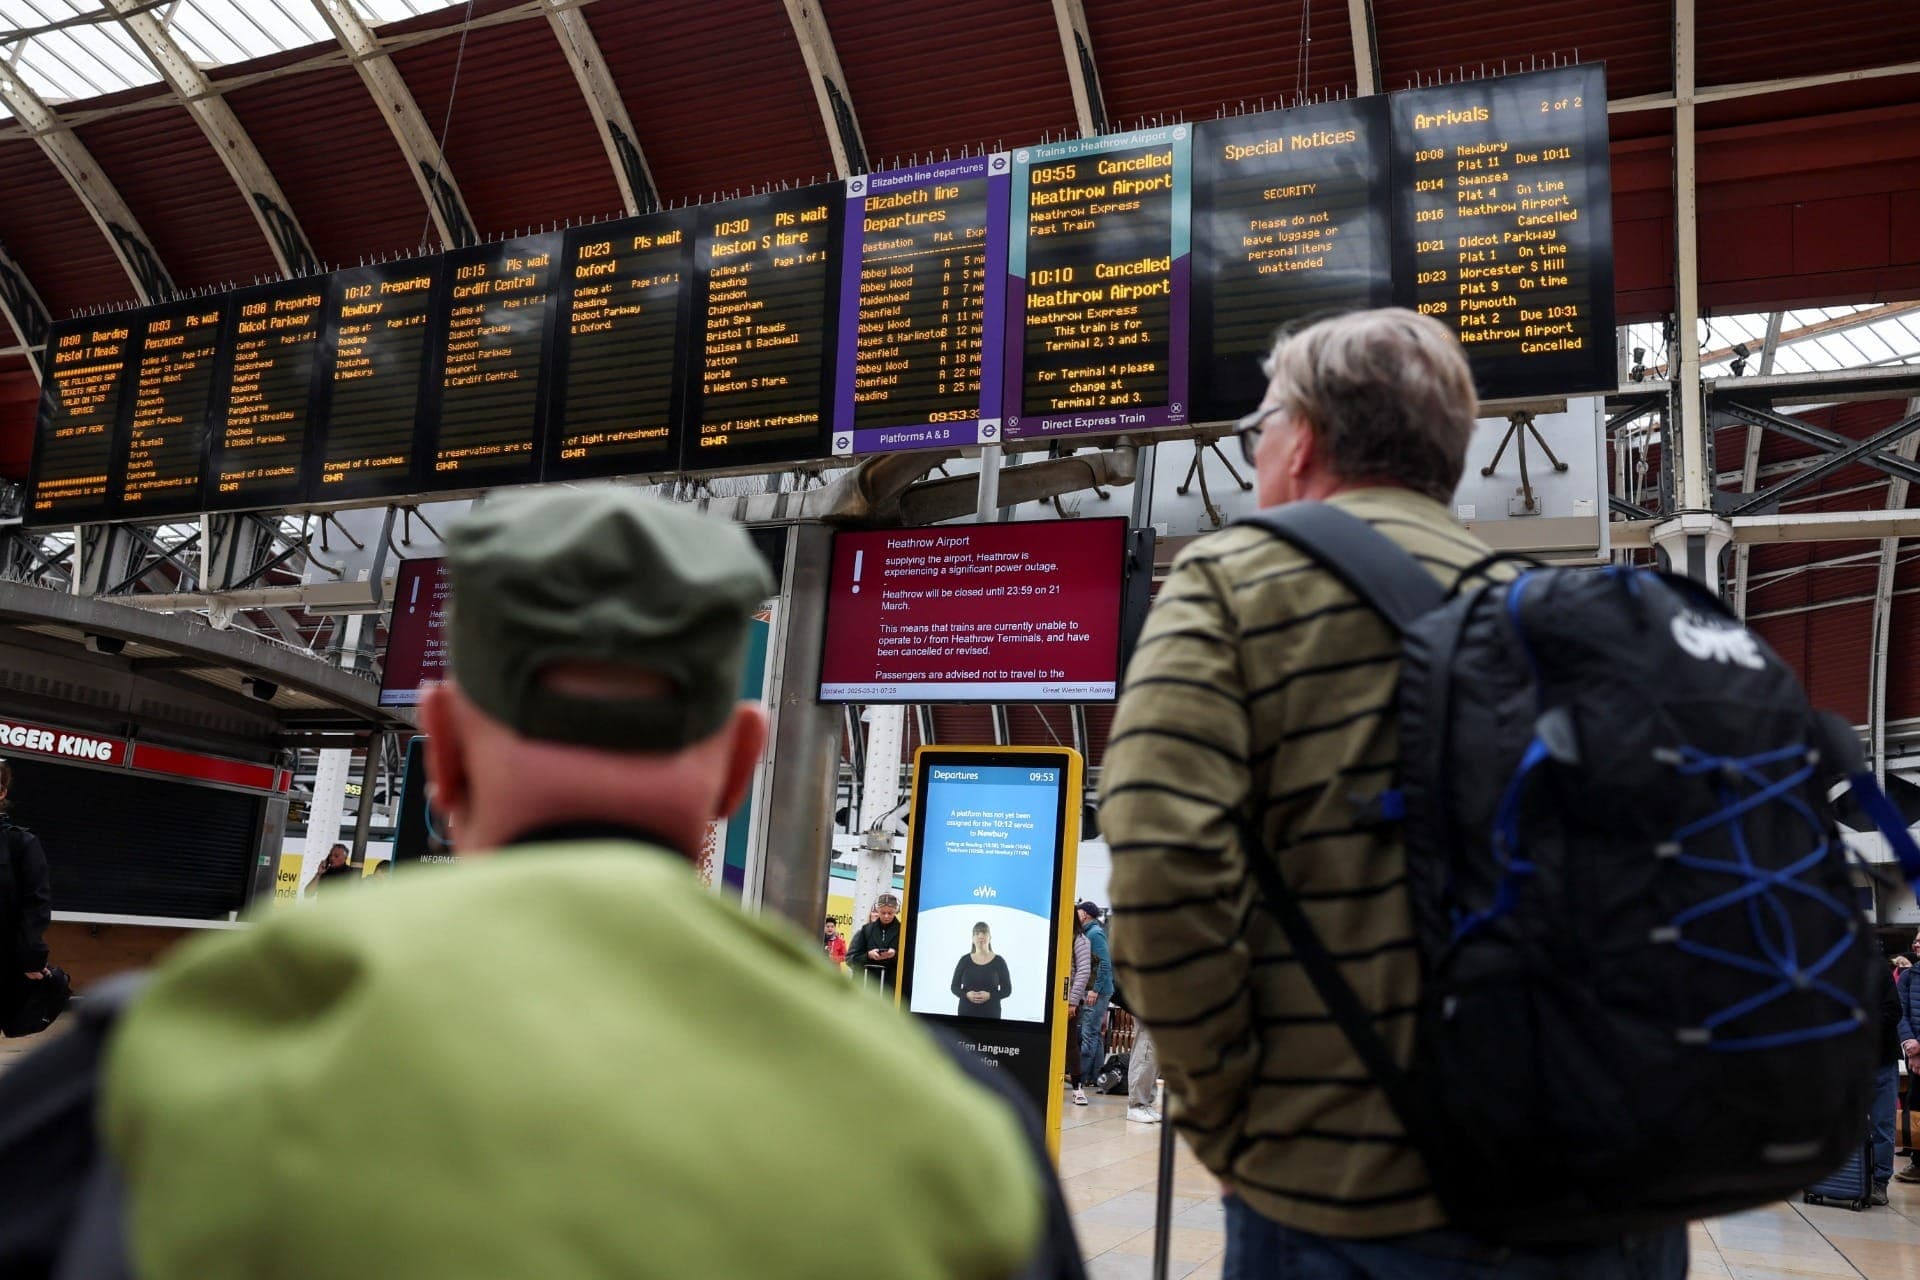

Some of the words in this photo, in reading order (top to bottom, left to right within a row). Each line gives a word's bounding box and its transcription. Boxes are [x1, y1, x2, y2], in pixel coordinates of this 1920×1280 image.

[1414, 107, 1488, 129] Arrivals
[1541, 101, 1549, 113] 2
[1553, 98, 1568, 110] of
[1574, 96, 1581, 108] 2
[1036, 148, 1065, 158] Trains
[1069, 145, 1078, 153] to
[1081, 138, 1128, 151] Heathrow
[1131, 132, 1166, 145] Airport
[1225, 138, 1284, 160] Special
[1290, 130, 1355, 150] Notices
[871, 173, 913, 188] Elizabeth
[914, 171, 931, 181] line
[933, 163, 984, 178] departures
[1032, 165, 1076, 184] 09:55
[1098, 152, 1172, 175] Cancelled
[1031, 186, 1106, 205] Heathrow
[1112, 174, 1171, 195] Airport
[1264, 184, 1315, 199] SECURITY
[1416, 178, 1444, 192] 10:14
[1458, 172, 1509, 186] Swansea
[1458, 189, 1483, 201] Plat
[1488, 188, 1496, 197] 4
[1516, 184, 1532, 195] On
[1536, 181, 1564, 192] time
[865, 190, 928, 211] Elizabeth
[934, 186, 959, 200] line
[1417, 209, 1444, 222] 10:16
[1458, 203, 1516, 216] Heathrow
[1521, 194, 1568, 209] Airport
[715, 219, 750, 236] 10:30
[775, 212, 795, 226] Pls
[800, 206, 827, 222] wait
[863, 210, 946, 232] Departures
[1030, 208, 1085, 222] Heathrow
[1089, 201, 1140, 214] Express
[1250, 218, 1287, 230] Please
[1291, 215, 1305, 225] do
[1309, 212, 1329, 223] not
[1517, 209, 1577, 226] Cancelled
[579, 242, 611, 258] 10:23
[634, 236, 652, 249] Pls
[656, 230, 681, 245] wait
[711, 240, 757, 257] Weston
[762, 235, 771, 249] S
[776, 232, 809, 246] Mare
[862, 238, 914, 252] Destination
[934, 231, 953, 241] Plat
[1243, 235, 1273, 246] leave
[1278, 229, 1321, 242] luggage
[1325, 227, 1337, 236] or
[1248, 245, 1297, 261] personal
[1301, 243, 1332, 254] items
[575, 260, 616, 278] Oxford
[861, 269, 887, 279] Abbey
[890, 264, 913, 275] Wood
[944, 258, 951, 267] A
[963, 255, 970, 265] 5
[1031, 267, 1073, 285] 10:10
[1095, 256, 1170, 278] Cancelled
[1258, 257, 1323, 274] unattended
[1417, 270, 1447, 284] 10:23
[1459, 264, 1524, 279] Worcester
[1530, 261, 1538, 272] S
[1543, 258, 1564, 270] Hill
[345, 285, 372, 299] 10:12
[380, 277, 431, 293] Preparing
[453, 281, 490, 297] Cardiff
[494, 274, 535, 291] Central
[1027, 290, 1103, 308] Heathrow
[1109, 279, 1169, 300] Airport
[1459, 282, 1485, 294] Plat
[1491, 280, 1499, 292] 9
[1519, 278, 1534, 289] On
[1539, 276, 1568, 286] time
[243, 302, 267, 316] 10:08
[275, 295, 321, 311] Preparing
[341, 303, 382, 317] Newbury
[573, 298, 608, 309] Reading
[708, 301, 763, 315] Chippenham
[1460, 314, 1486, 326] Plat
[1491, 312, 1499, 324] 2
[1520, 310, 1543, 321] Due
[1548, 305, 1577, 318] 10:31
[1054, 325, 1076, 336] This
[1080, 322, 1107, 334] train
[1110, 322, 1119, 331] is
[1123, 319, 1142, 329] for
[856, 375, 898, 387] Shenfield
[939, 369, 946, 379] A
[953, 367, 966, 378] 22
[1038, 371, 1056, 380] For
[1061, 366, 1106, 379] Terminal
[1109, 364, 1117, 374] 4
[1119, 363, 1155, 375] please
[854, 391, 888, 401] Reading
[938, 384, 945, 393] B
[953, 381, 965, 392] 25
[1069, 382, 1106, 393] change
[1110, 379, 1122, 390] at
[1051, 396, 1095, 408] Terminal
[1098, 395, 1106, 405] 2
[1109, 393, 1130, 404] and
[1132, 392, 1141, 402] 3.
[1042, 419, 1072, 430] Direct
[1074, 417, 1116, 428] Express
[1119, 413, 1145, 423] Train
[880, 432, 925, 444] Platforms
[925, 430, 932, 439] A
[934, 430, 941, 439] &
[943, 429, 950, 438] B
[887, 538, 934, 549] Heathrow
[935, 536, 970, 548] Airport
[885, 556, 926, 566] supplying
[927, 555, 941, 563] the
[943, 554, 973, 564] airport,
[976, 552, 1020, 561] Heathrow
[1021, 552, 1029, 560] is
[882, 590, 924, 599] Heathrow
[925, 588, 939, 598] will
[941, 588, 953, 597] be
[954, 587, 983, 597] closed
[985, 586, 1005, 596] until
[1006, 585, 1033, 595] 23:59
[1048, 584, 1060, 594] 21
[877, 647, 899, 656] been
[900, 646, 942, 656] cancelled
[955, 645, 990, 655] revised.
[58, 735, 112, 760] KING
[934, 770, 978, 781] Departures
[1029, 772, 1054, 781] 09:53
[977, 829, 1008, 839] Newbury
[420, 855, 464, 865] INFORMAT
[973, 885, 996, 898] GWR
[978, 1043, 1020, 1056] Language
